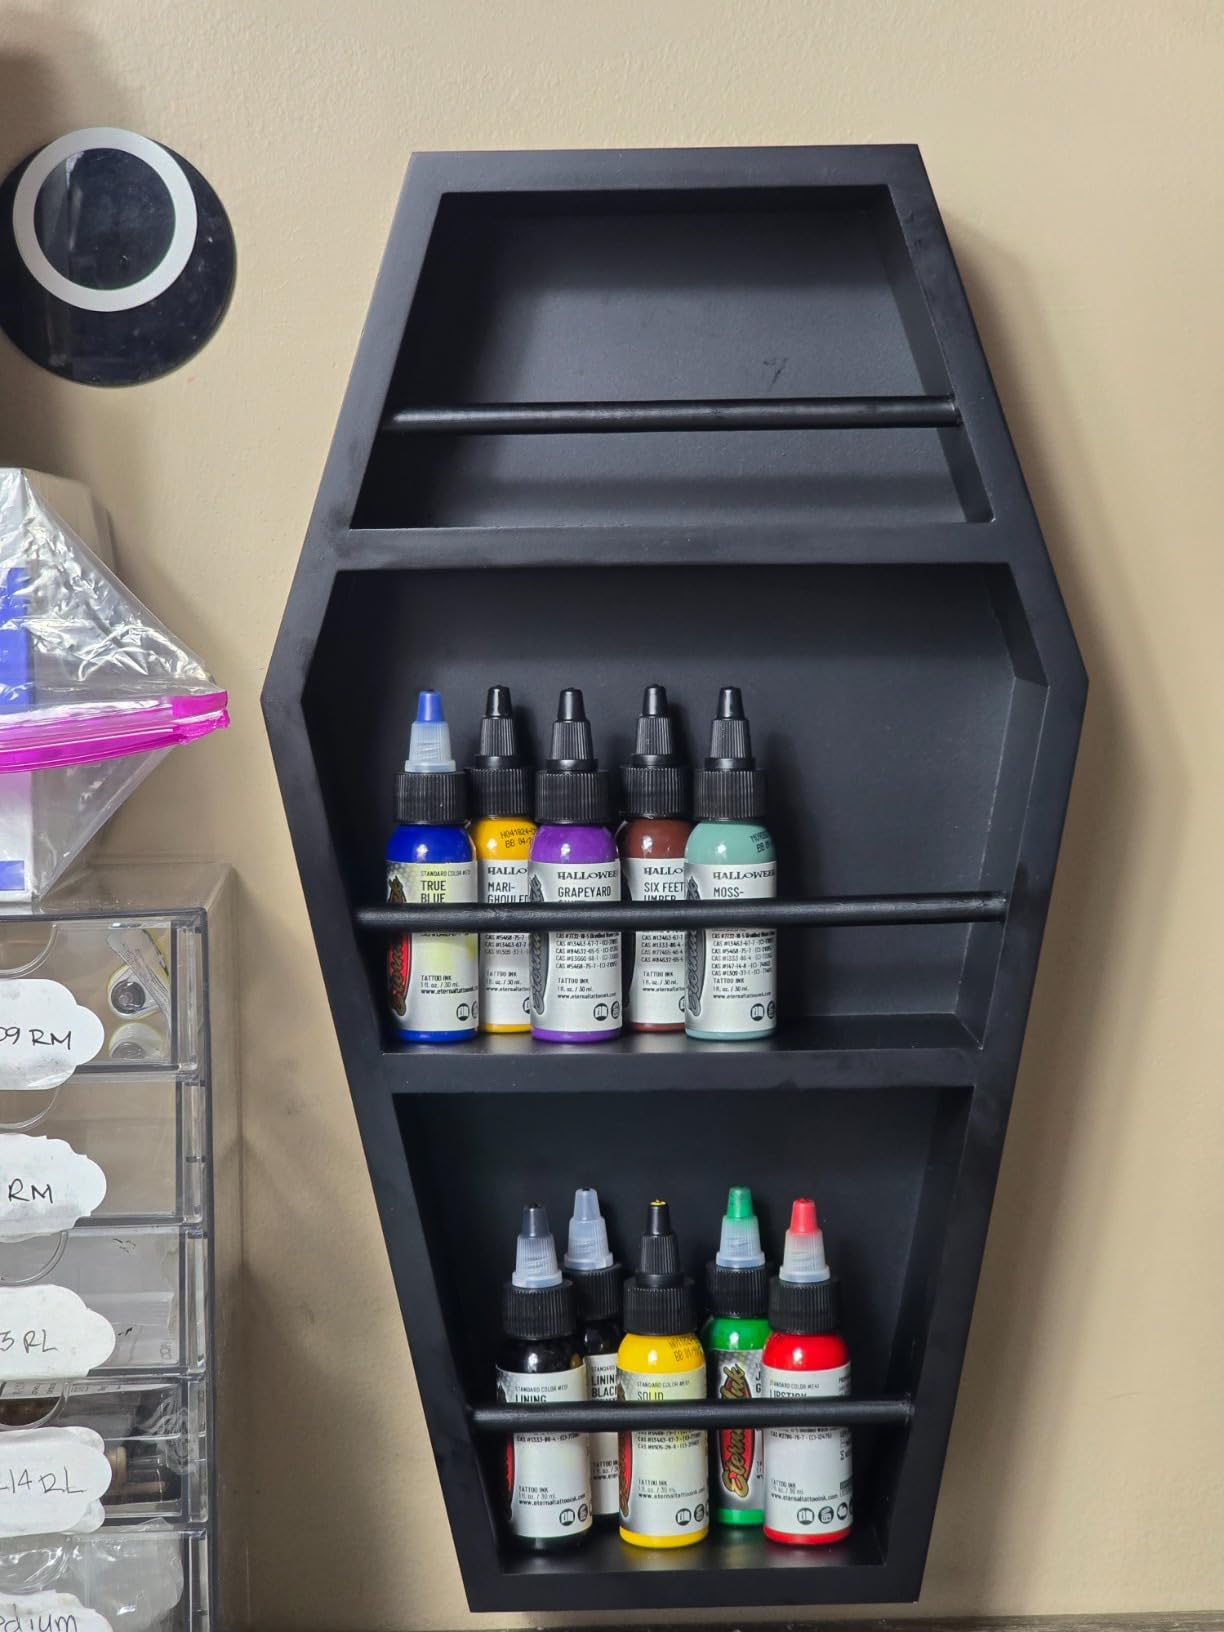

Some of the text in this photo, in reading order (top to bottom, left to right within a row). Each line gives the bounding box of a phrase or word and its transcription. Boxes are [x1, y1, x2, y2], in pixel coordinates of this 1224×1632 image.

[488, 867, 527, 875] HALLO
[643, 867, 683, 875] HALLO
[421, 880, 446, 891] TRUE
[488, 882, 515, 893] MARI-
[644, 882, 685, 893] SIX FEET
[557, 886, 612, 898] GRAPEYARD
[713, 887, 744, 898] MOSS-
[421, 893, 445, 903] BLUE
[29, 1029, 72, 1051] RM
[8, 1178, 53, 1204] RM
[23, 1328, 60, 1354] RL
[591, 1374, 615, 1387] LININ
[515, 1394, 547, 1402] LINING
[637, 1391, 664, 1400] SOLID
